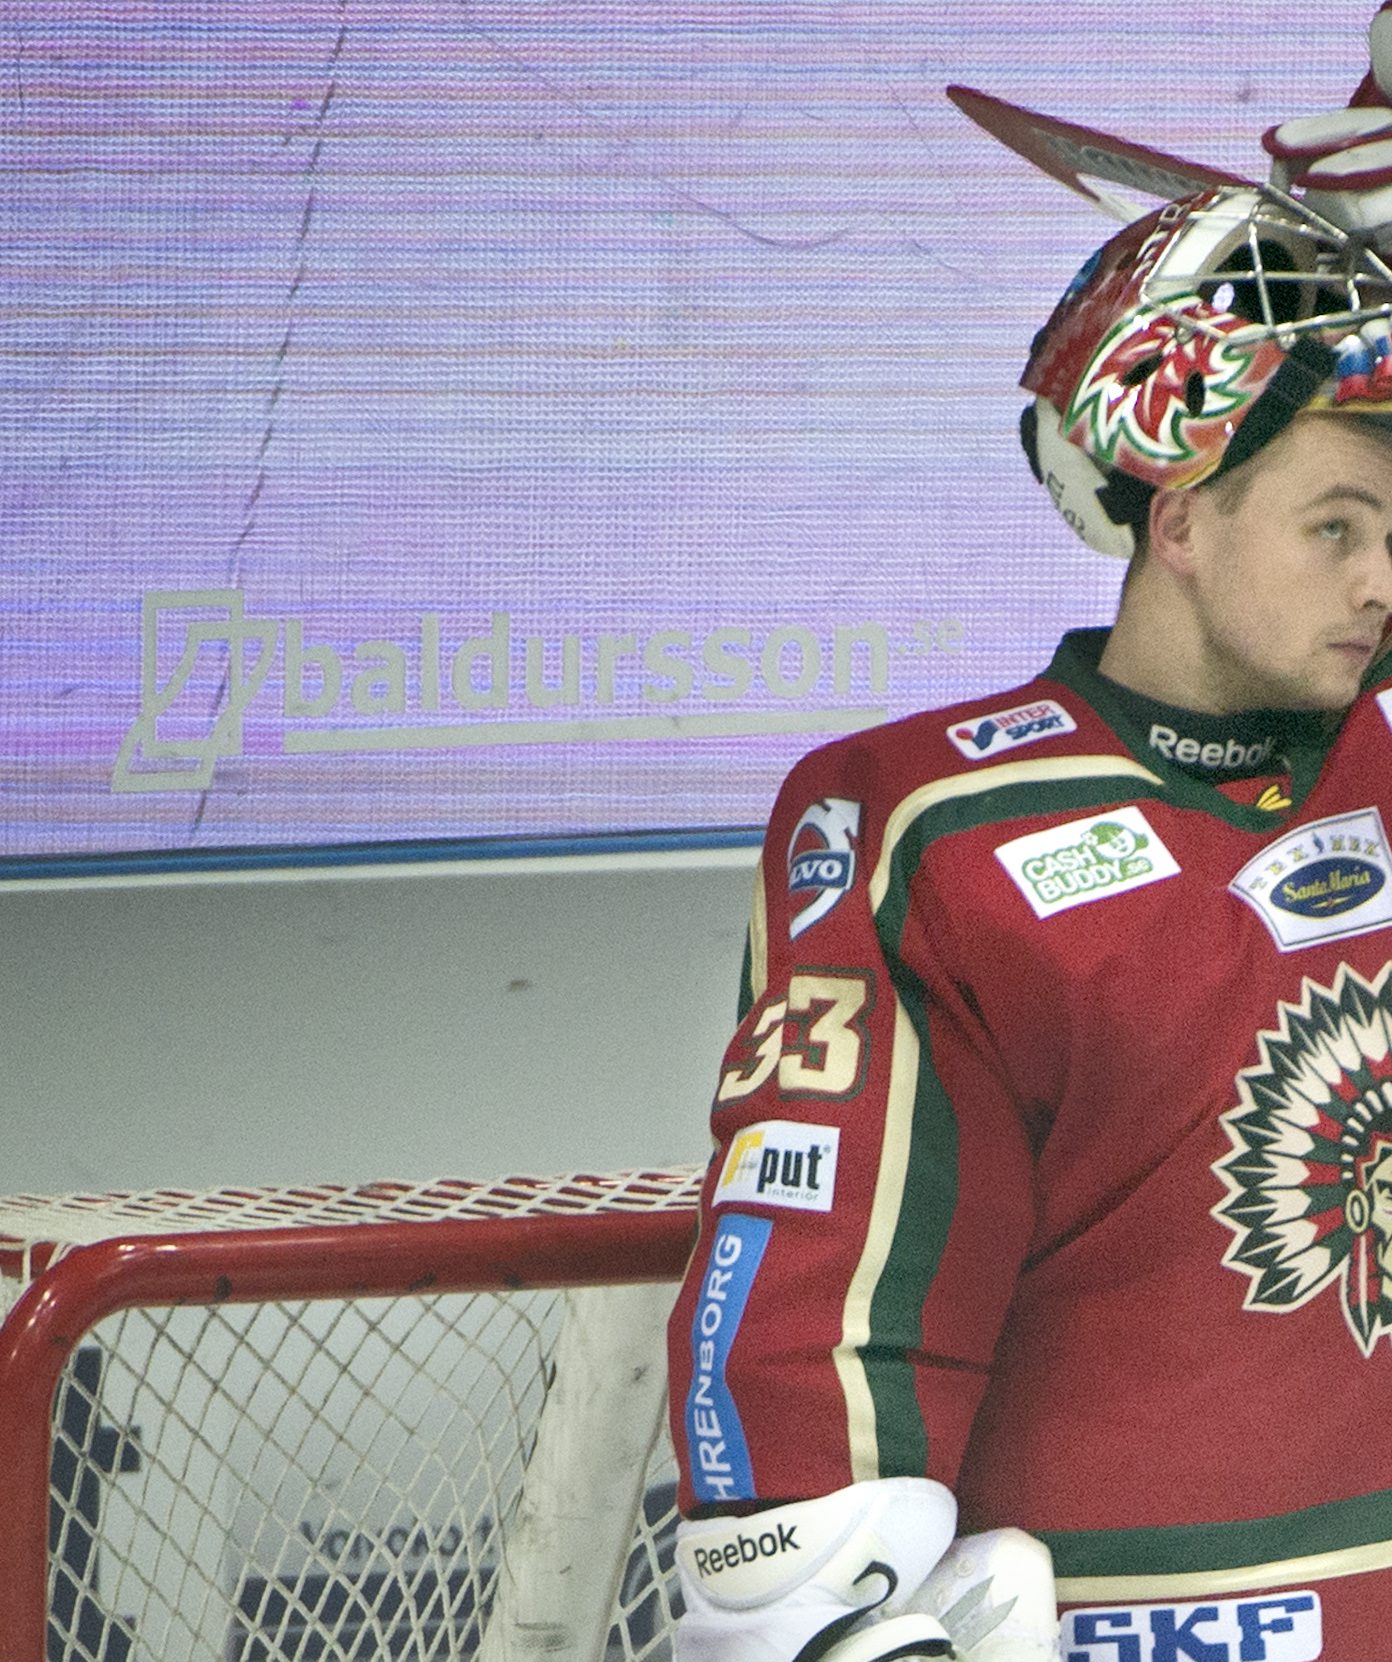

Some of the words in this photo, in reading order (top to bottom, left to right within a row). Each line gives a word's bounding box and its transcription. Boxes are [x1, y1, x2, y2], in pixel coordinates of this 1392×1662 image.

[1024, 845, 1097, 881] CASH
[716, 971, 871, 1106] 33
[693, 1523, 801, 1579] Reebok
